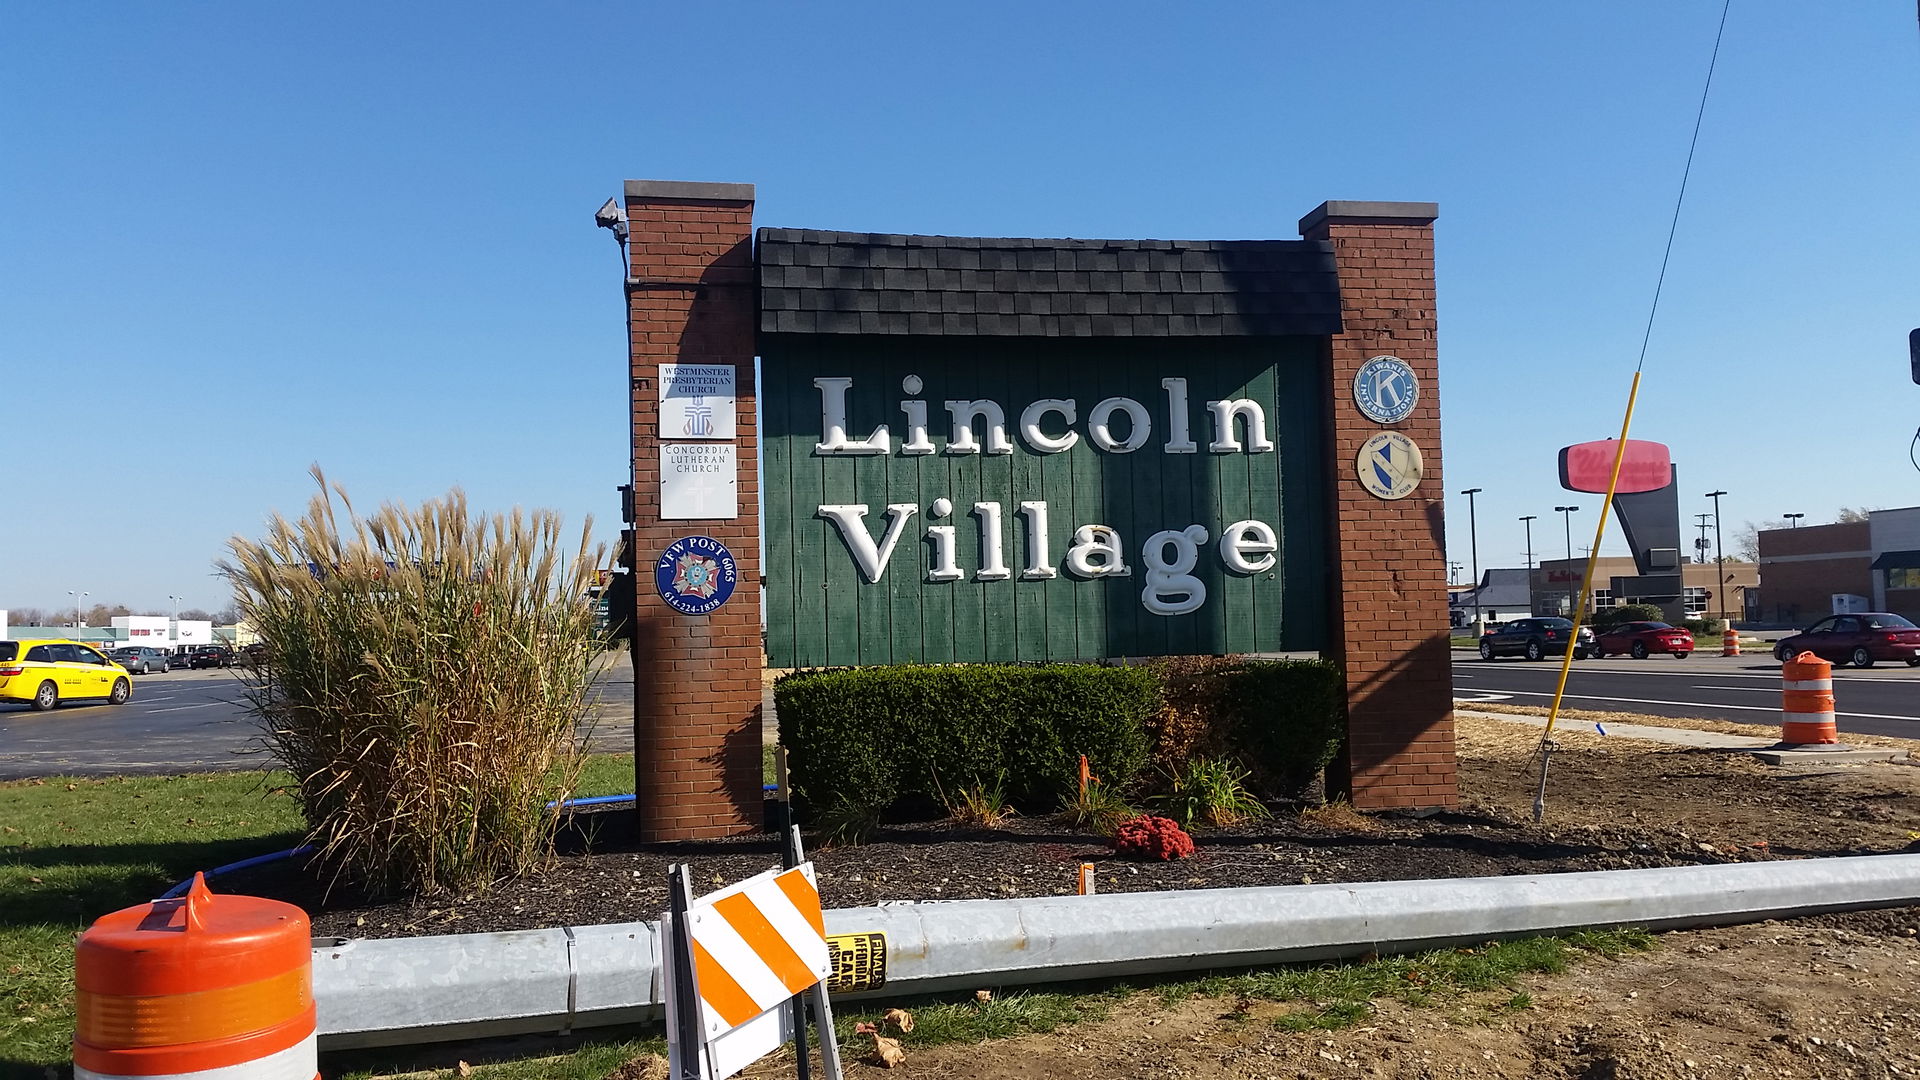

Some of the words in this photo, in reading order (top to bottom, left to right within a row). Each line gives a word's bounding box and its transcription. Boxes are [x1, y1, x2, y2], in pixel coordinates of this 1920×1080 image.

[664, 367, 730, 376] WESTMINSTER
[1366, 362, 1407, 377] KIWANIS
[663, 376, 731, 385] PRESBYTERIAN
[678, 385, 716, 394] CHURCH
[1360, 383, 1413, 416] INTERNATIONAL
[813, 374, 1274, 455] Lincoln
[1368, 434, 1388, 448] LINCOLN
[1392, 434, 1412, 448] VILLAGE
[665, 446, 730, 455] CONCORDIA
[671, 455, 726, 464] LUTHERAN
[676, 464, 720, 473] CHURCH
[1399, 483, 1412, 494] CLUB
[660, 540, 686, 569] VFW
[689, 538, 726, 556] POST
[721, 557, 736, 583] 6065
[817, 497, 1278, 616] Village
[664, 591, 721, 612] 614-224-1838
[826, 940, 841, 991] INSURAN
[841, 950, 854, 987] CAR
[854, 937, 868, 991] AFFORDAB
